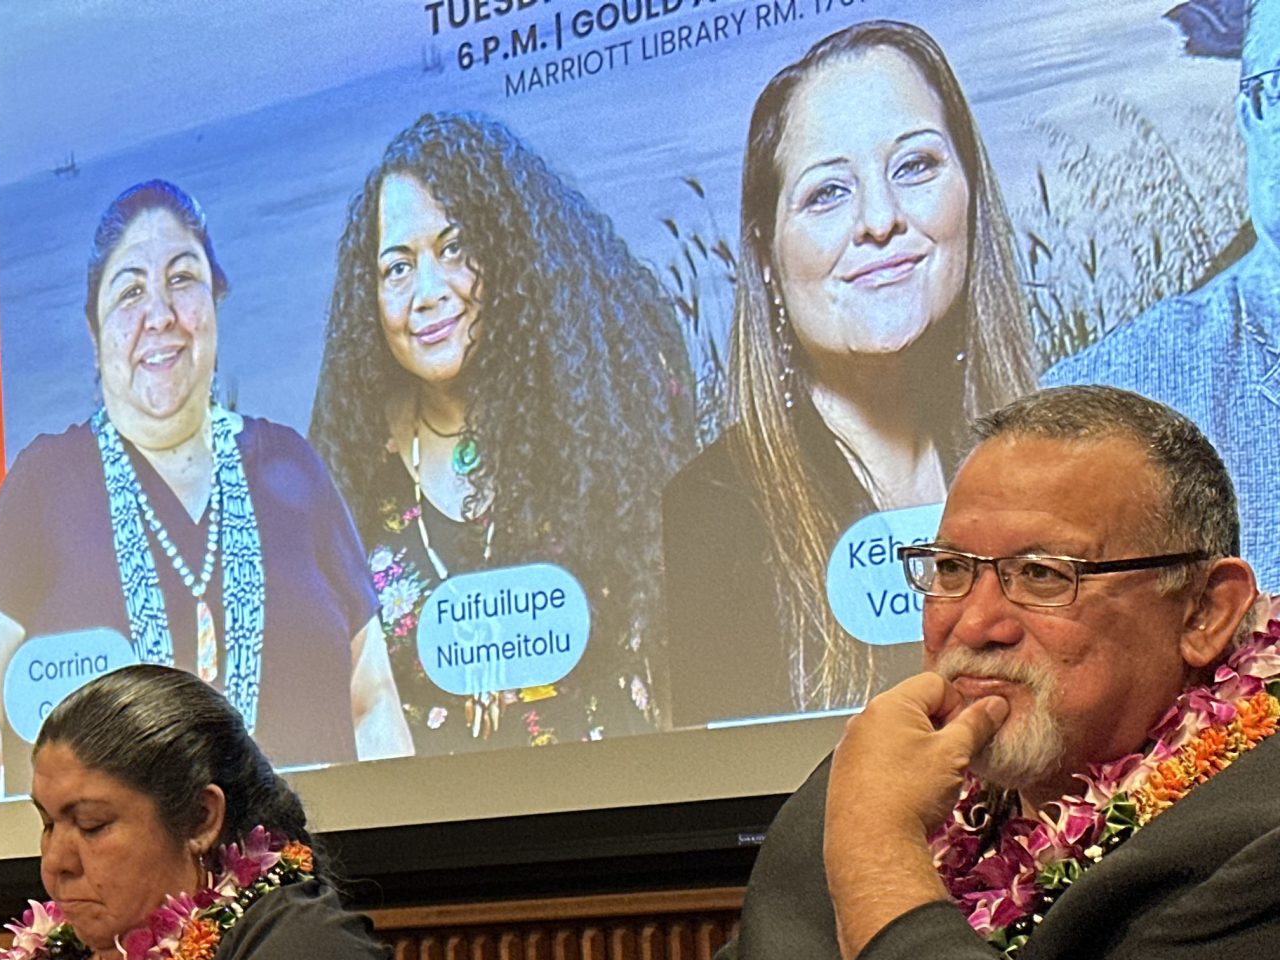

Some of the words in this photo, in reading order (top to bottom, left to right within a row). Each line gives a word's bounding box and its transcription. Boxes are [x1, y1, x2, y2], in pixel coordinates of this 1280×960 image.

[458, 41, 474, 71] 6
[483, 24, 547, 65] P.M.
[505, 40, 632, 98] MARRIOTT
[642, 9, 746, 61] LIBRARY
[756, 0, 804, 30] RM.
[437, 588, 566, 625] Fuifuilupe
[28, 652, 108, 682] Corrina
[437, 629, 570, 668] Niumeitolu
